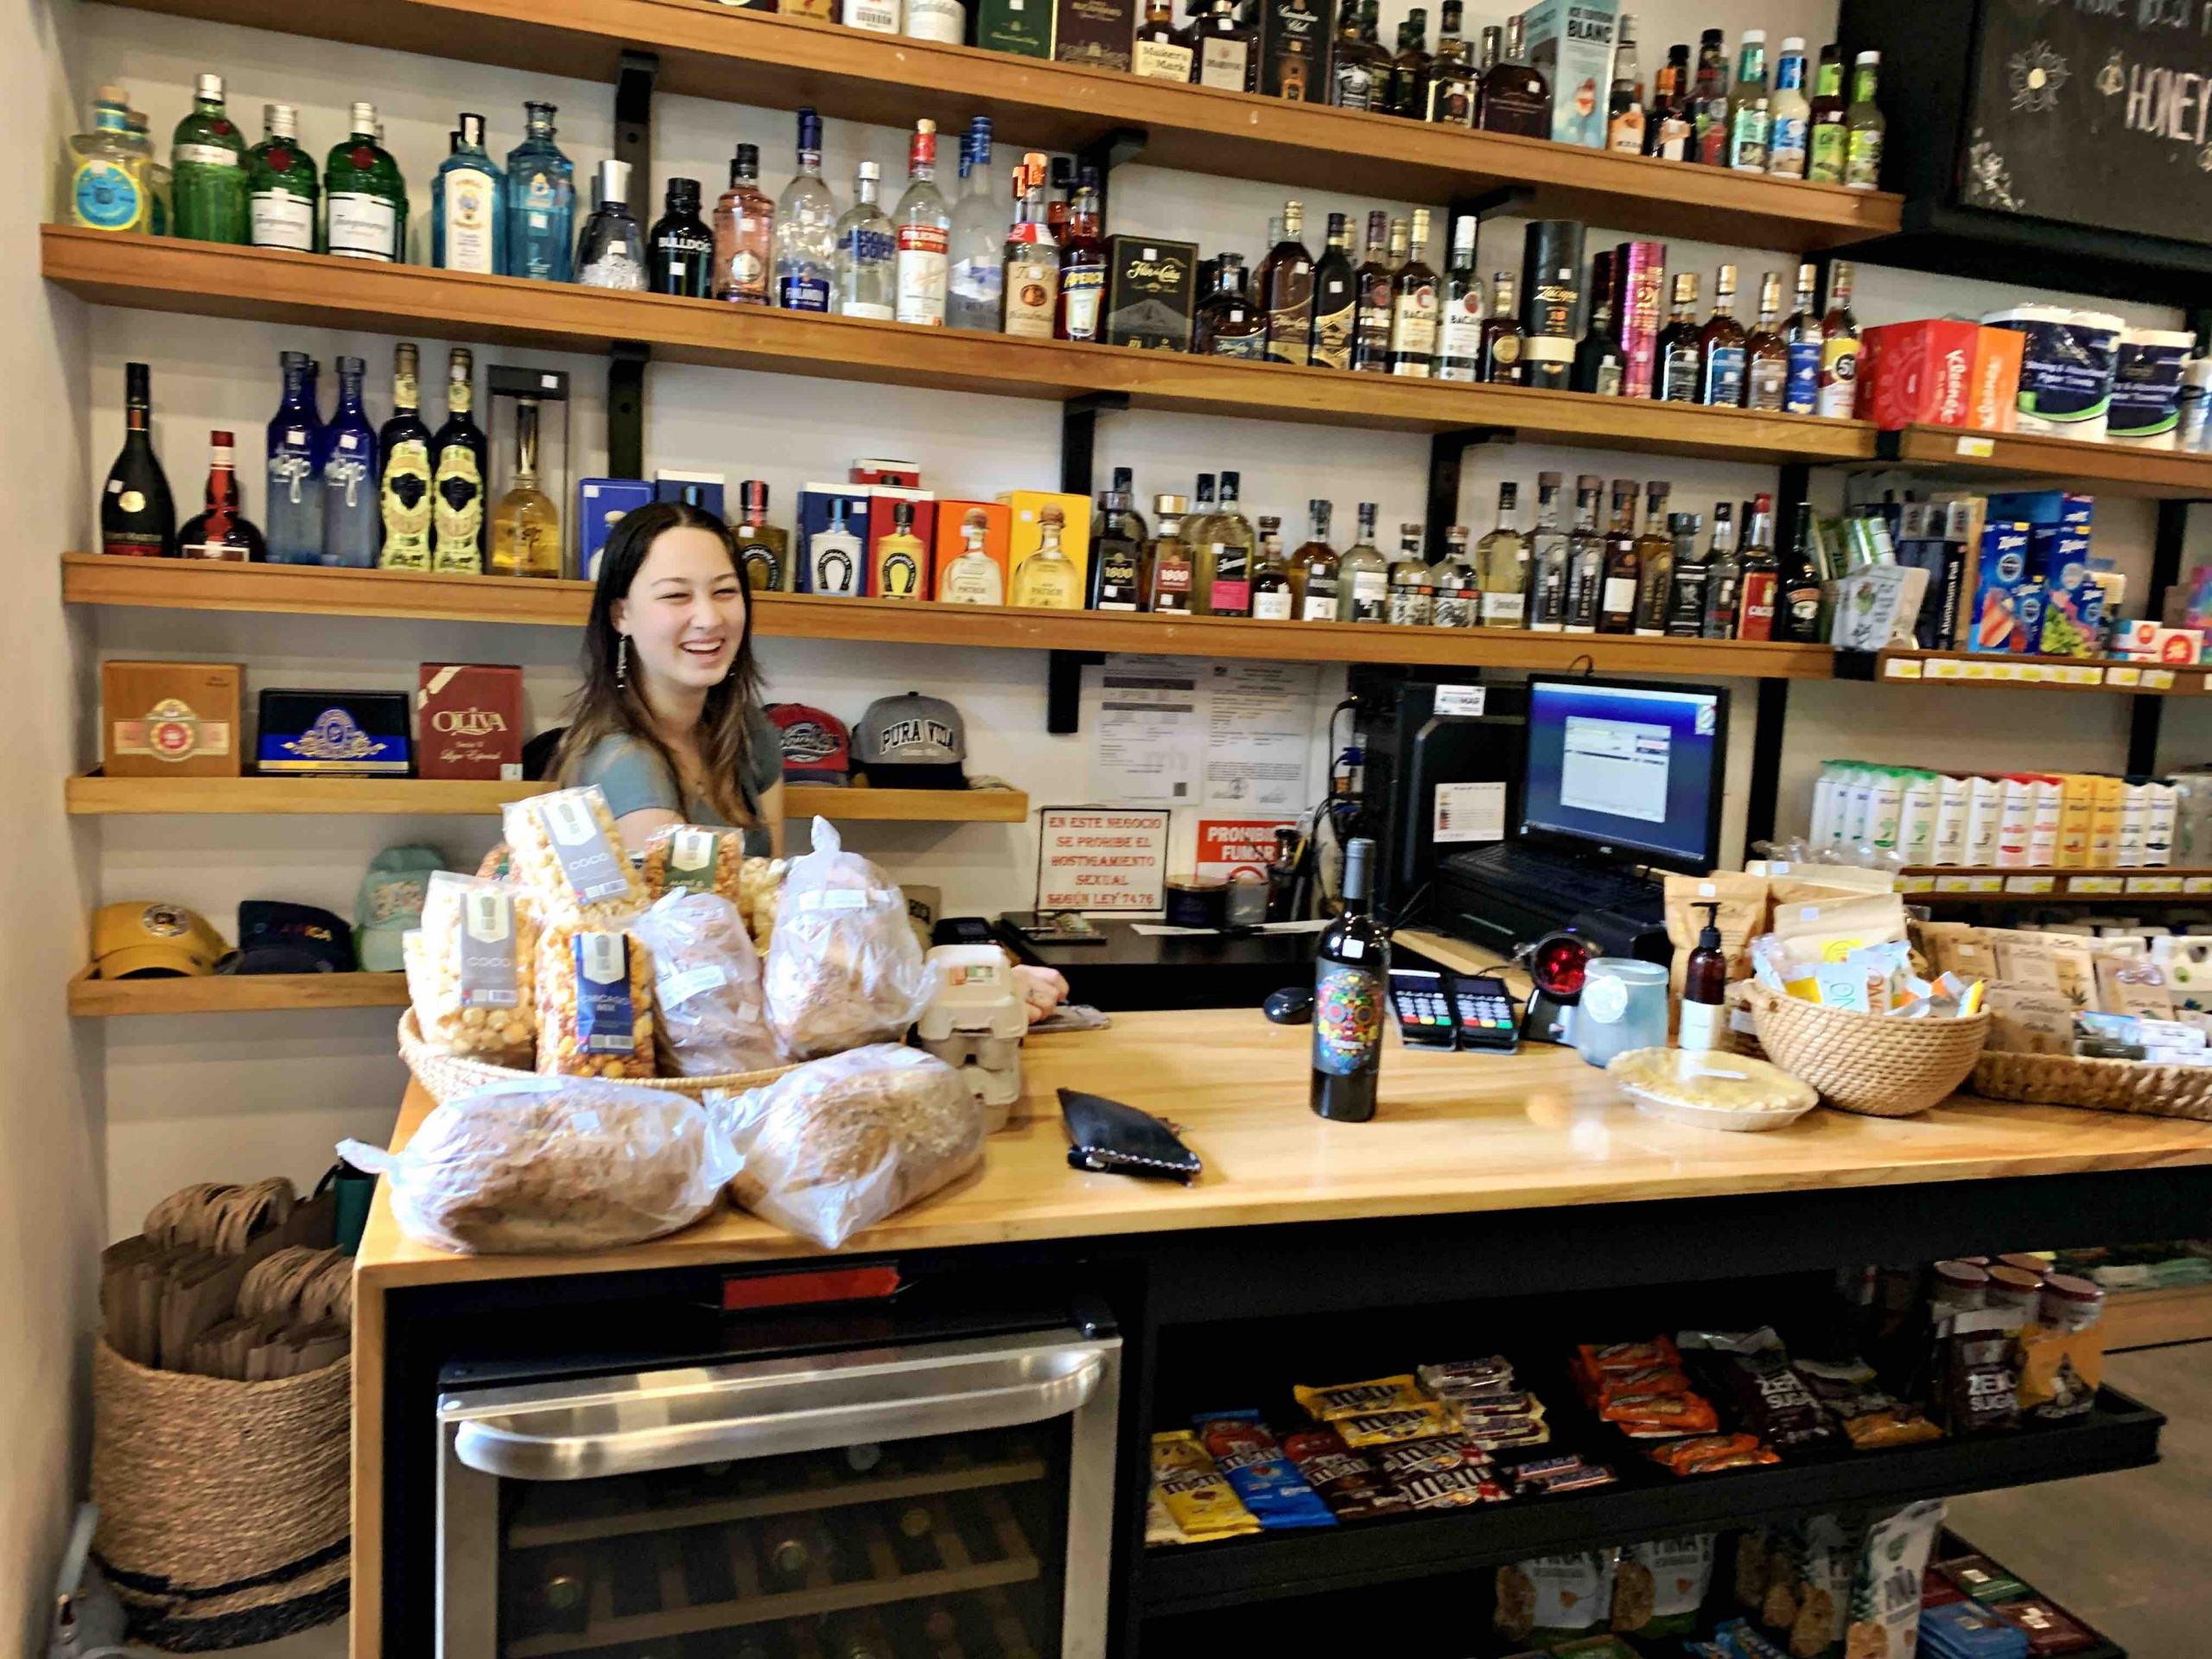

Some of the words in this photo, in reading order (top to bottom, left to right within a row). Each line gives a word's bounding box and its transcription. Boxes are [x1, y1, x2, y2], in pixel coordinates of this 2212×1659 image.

[431, 708, 508, 734] OLIVA
[879, 718, 924, 756] PURA
[1049, 817, 1066, 829] EN
[1070, 817, 1103, 829] ESTE
[1107, 817, 1161, 830] NEGOCIO
[1056, 836, 1073, 848] SE
[1077, 836, 1134, 849] PROHIBE
[1136, 836, 1153, 848] EL
[1222, 845, 1274, 861] FUMAR
[568, 852, 610, 872] COCO
[1076, 874, 1129, 887] SEXUAL
[1093, 893, 1120, 905] LEY
[1122, 893, 1156, 905] 7476
[467, 956, 512, 968] COCO
